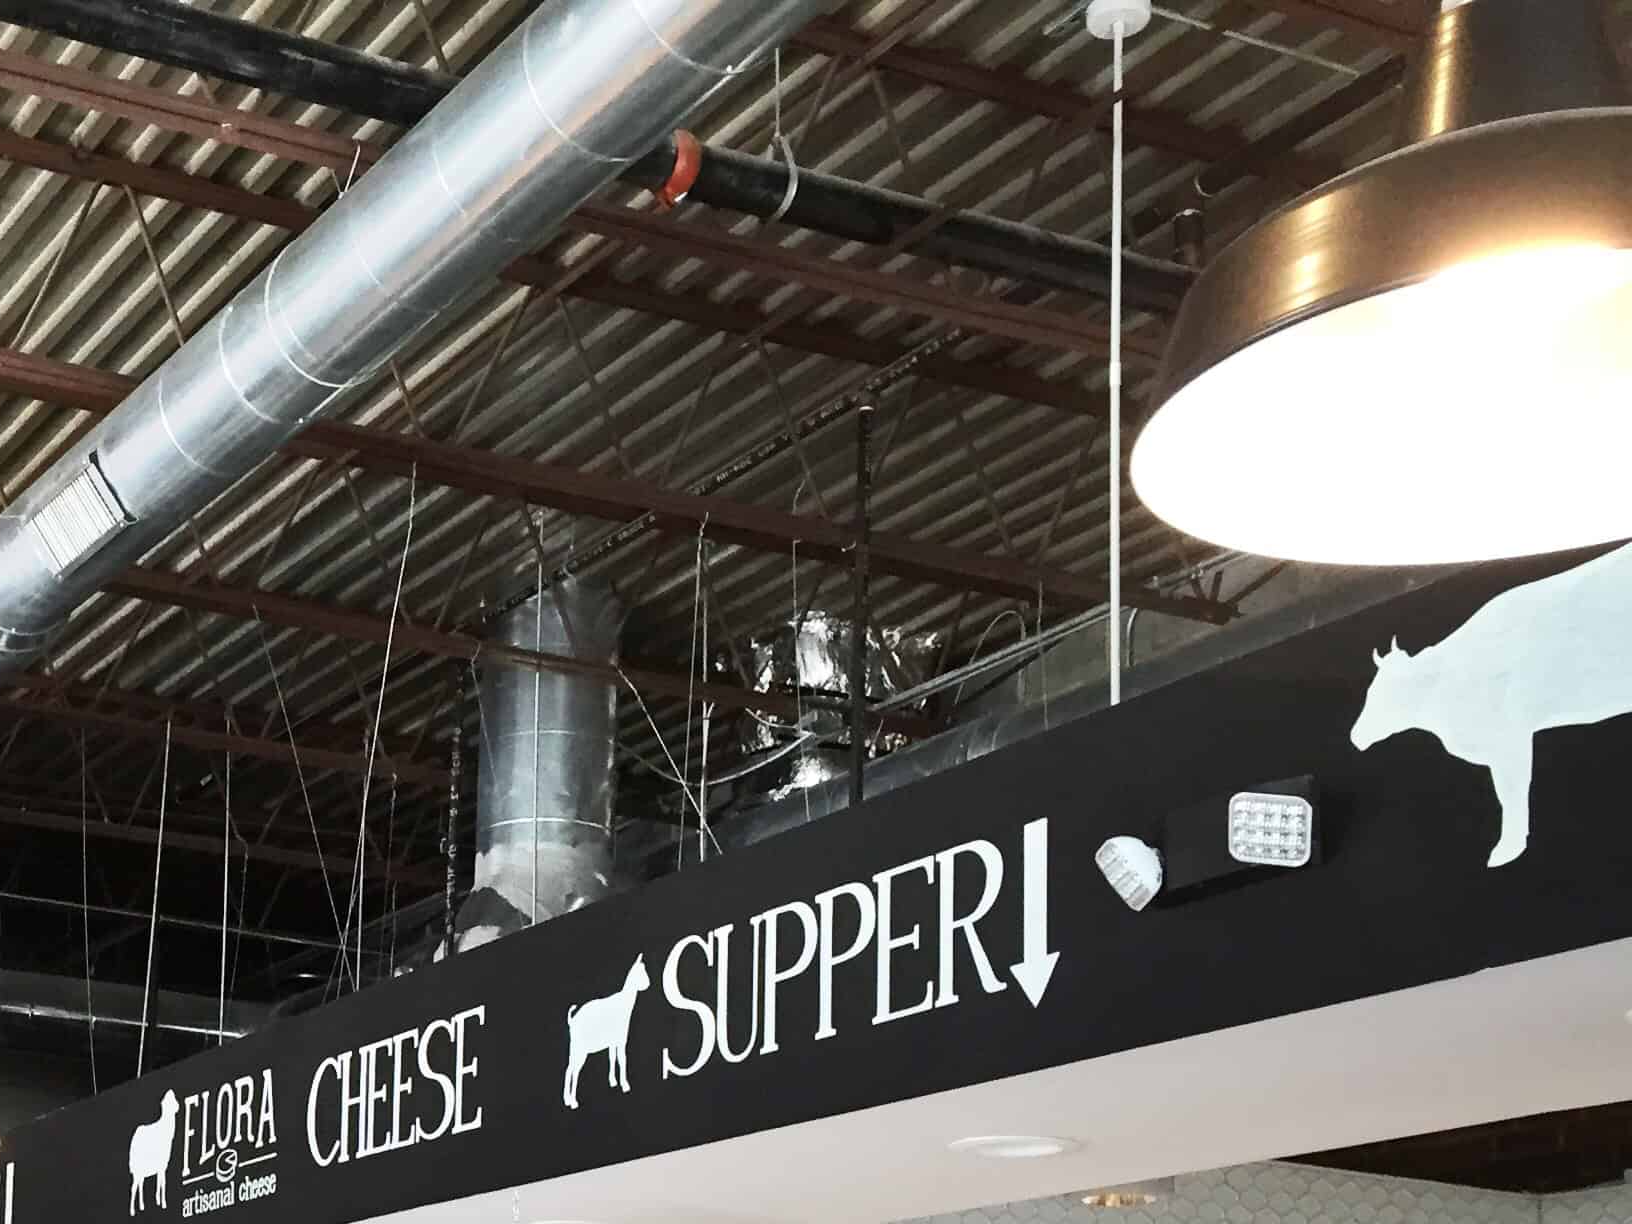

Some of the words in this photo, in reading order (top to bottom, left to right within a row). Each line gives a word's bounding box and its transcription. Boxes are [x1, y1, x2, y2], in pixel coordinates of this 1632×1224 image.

[663, 839, 1007, 1080] SUPPER
[182, 1068, 277, 1177] FLORA
[307, 1005, 486, 1167] CHEESE
[182, 1181, 235, 1218] artisanal
[239, 1173, 277, 1202] cheese
